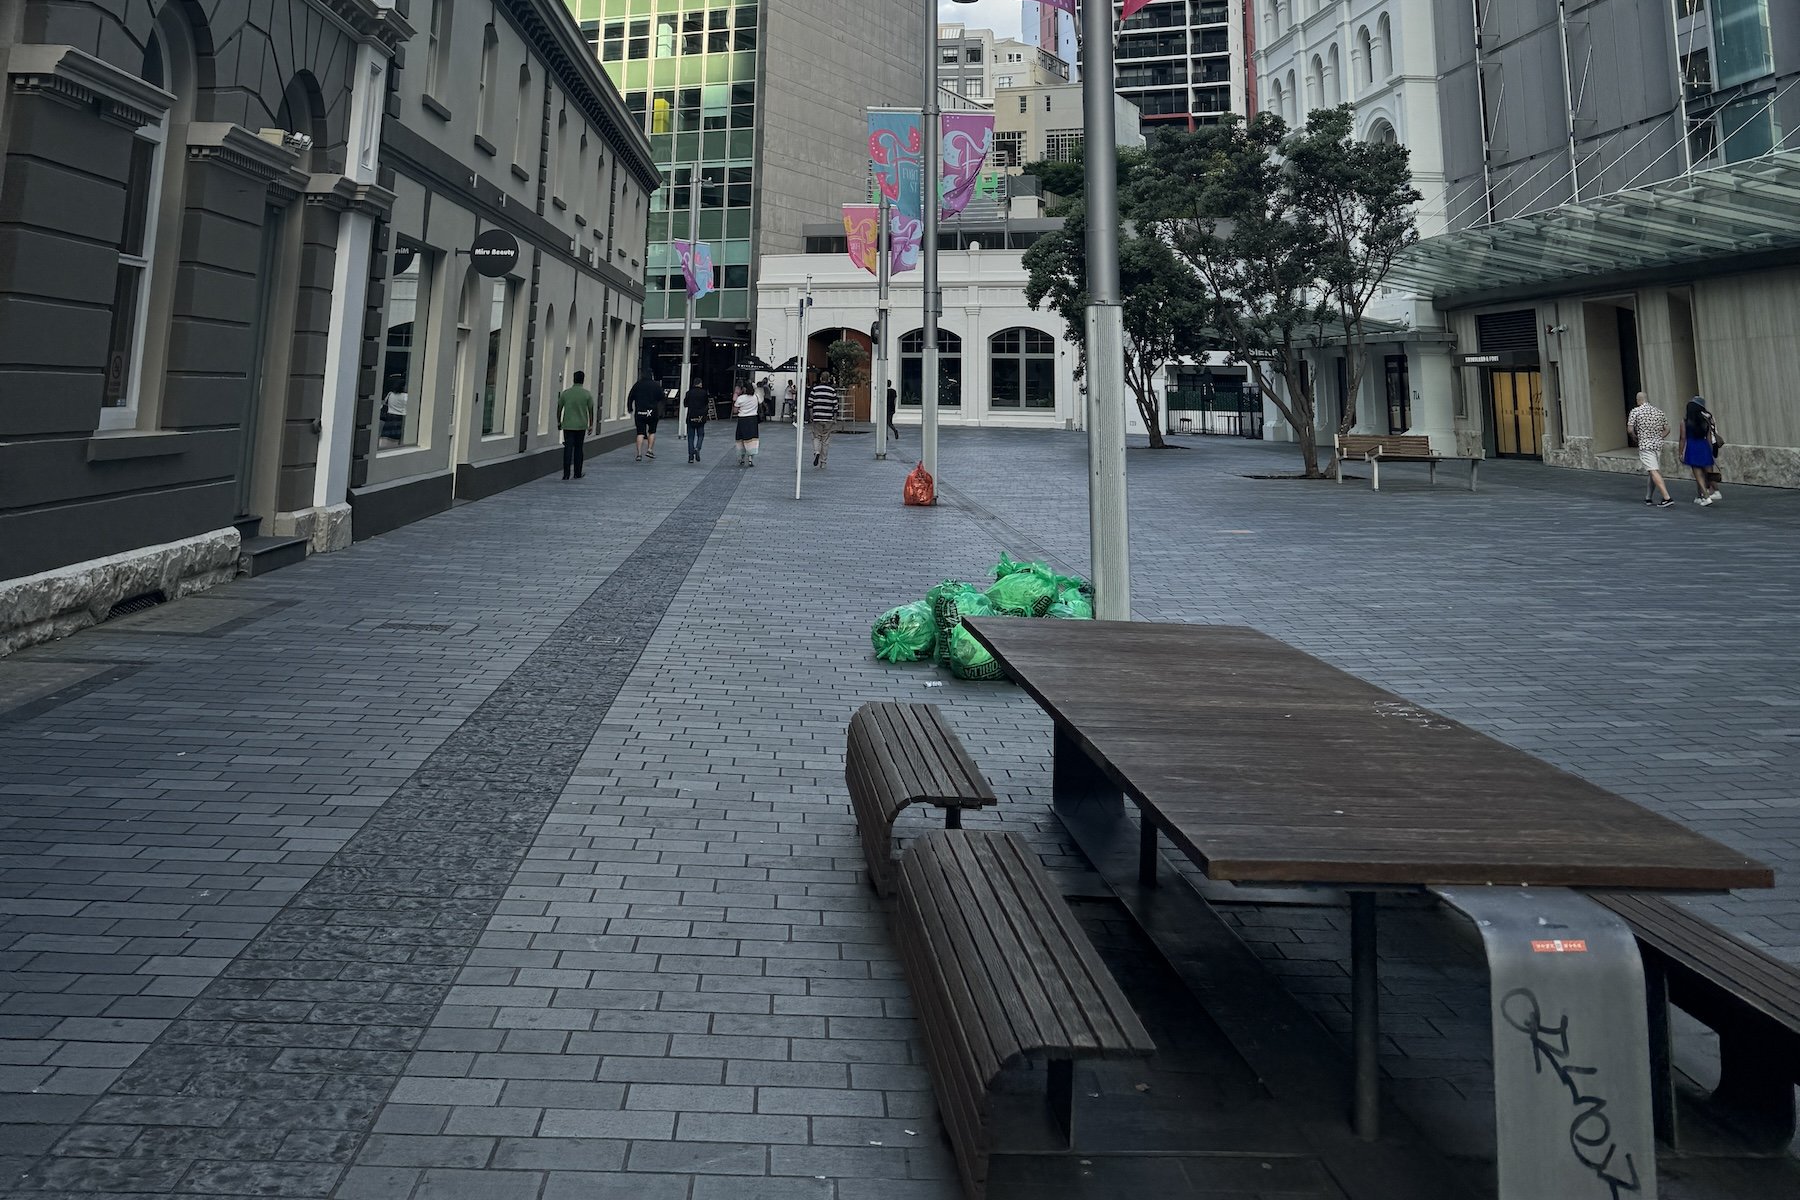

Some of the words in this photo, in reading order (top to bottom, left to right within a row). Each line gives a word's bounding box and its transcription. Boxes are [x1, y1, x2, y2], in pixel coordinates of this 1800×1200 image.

[491, 248, 515, 257] Beauty
[768, 338, 777, 391] VIVCE
[964, 660, 998, 679] ORILLA
